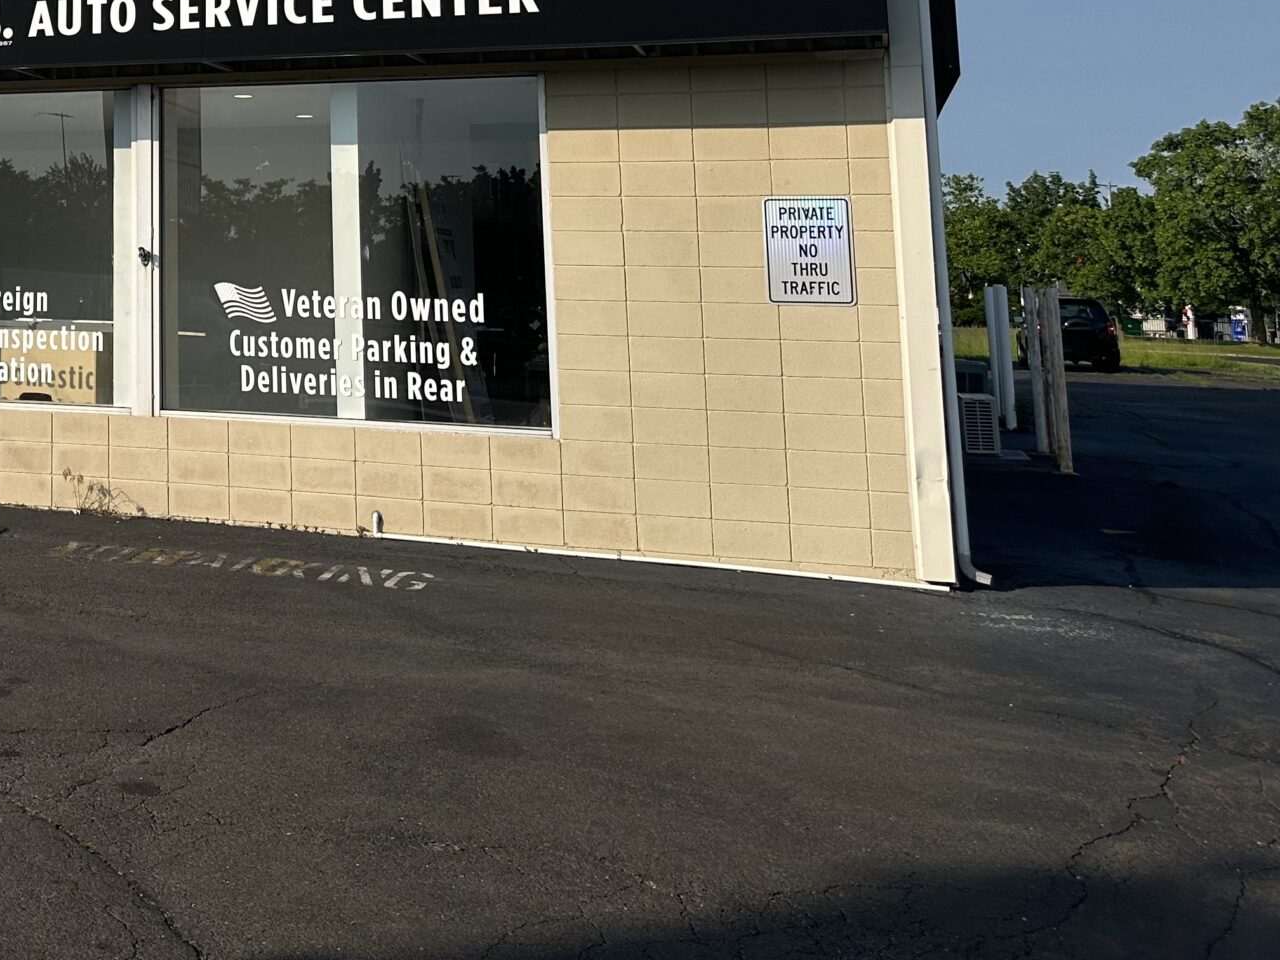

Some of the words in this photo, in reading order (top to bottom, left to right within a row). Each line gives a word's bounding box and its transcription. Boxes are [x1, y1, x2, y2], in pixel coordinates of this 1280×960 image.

[778, 206, 835, 221] PRIVATE
[770, 225, 844, 240] PROPERTY
[798, 243, 818, 258] NO
[791, 262, 828, 277] THRU
[781, 281, 841, 296] TRAFFIC
[281, 288, 381, 320] Veteran
[391, 290, 485, 323] Owned
[229, 329, 343, 361] Customer
[351, 332, 451, 370] Parking
[460, 336, 478, 367] &
[240, 364, 366, 398] Deliveries
[374, 369, 398, 399] in
[407, 371, 466, 403] Rear
